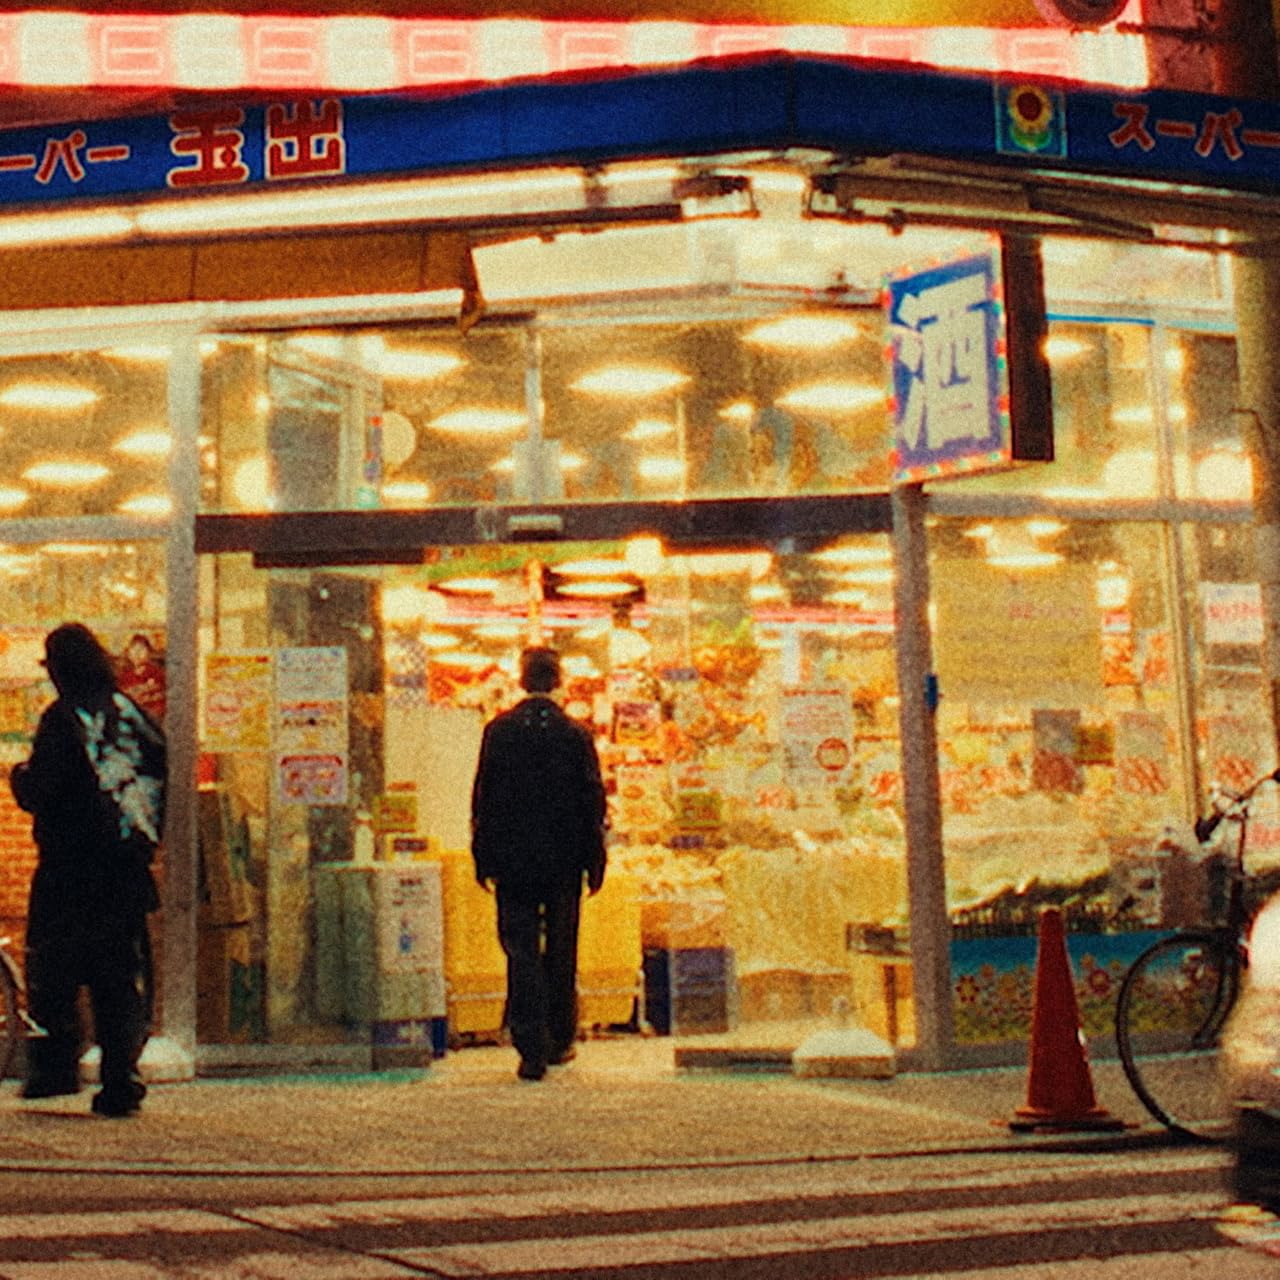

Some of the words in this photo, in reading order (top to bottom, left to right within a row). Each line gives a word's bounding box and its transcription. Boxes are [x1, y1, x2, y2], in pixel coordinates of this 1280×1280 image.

[166, 98, 348, 188] 玉出
[1109, 103, 1280, 160] スーパー
[893, 270, 1000, 452] 酒
